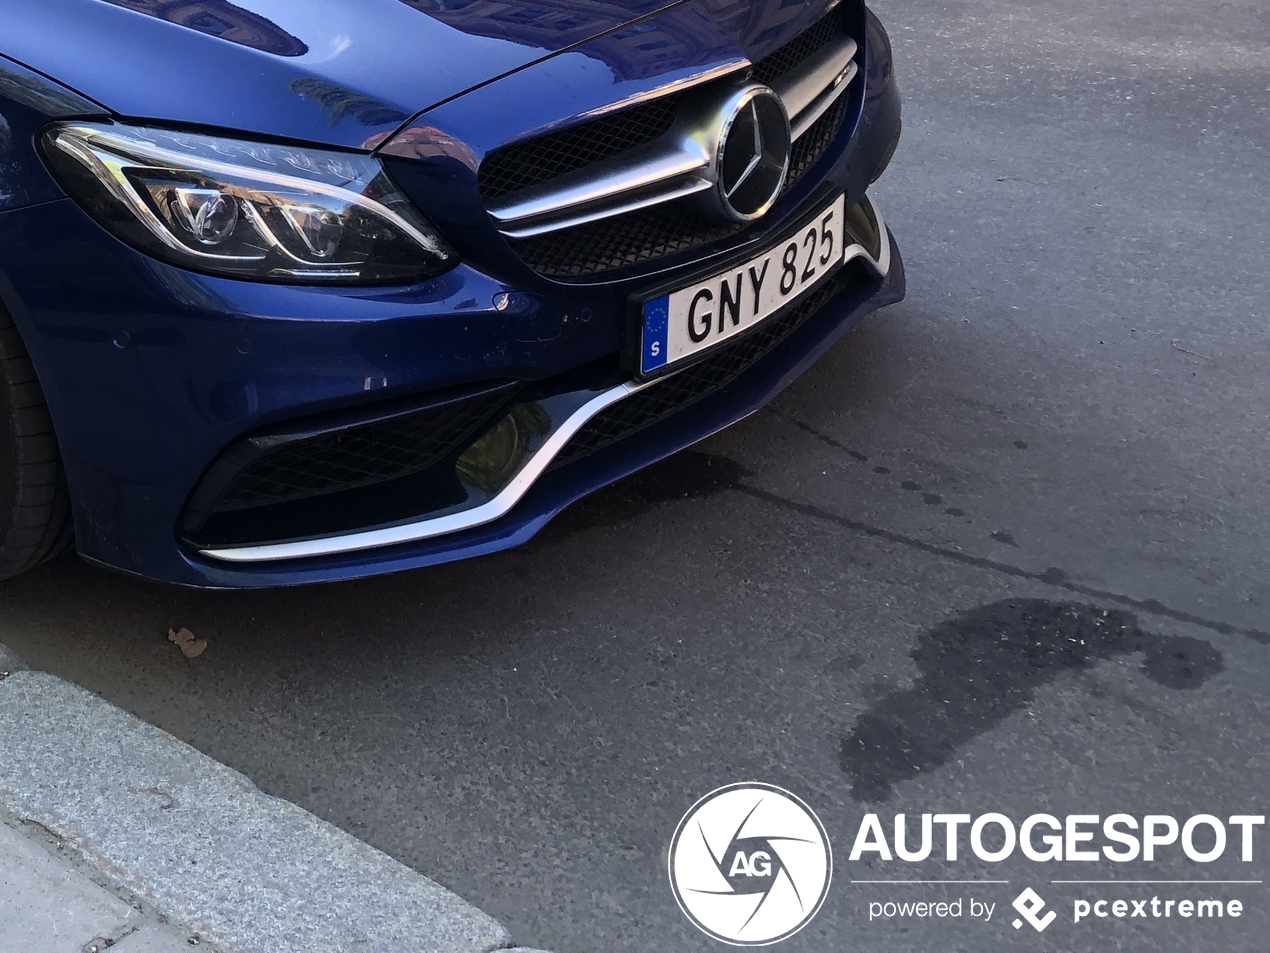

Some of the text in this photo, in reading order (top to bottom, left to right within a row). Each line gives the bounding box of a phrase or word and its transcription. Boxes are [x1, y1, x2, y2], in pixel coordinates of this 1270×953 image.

[687, 210, 834, 343] GNY 825
[651, 341, 660, 357] S
